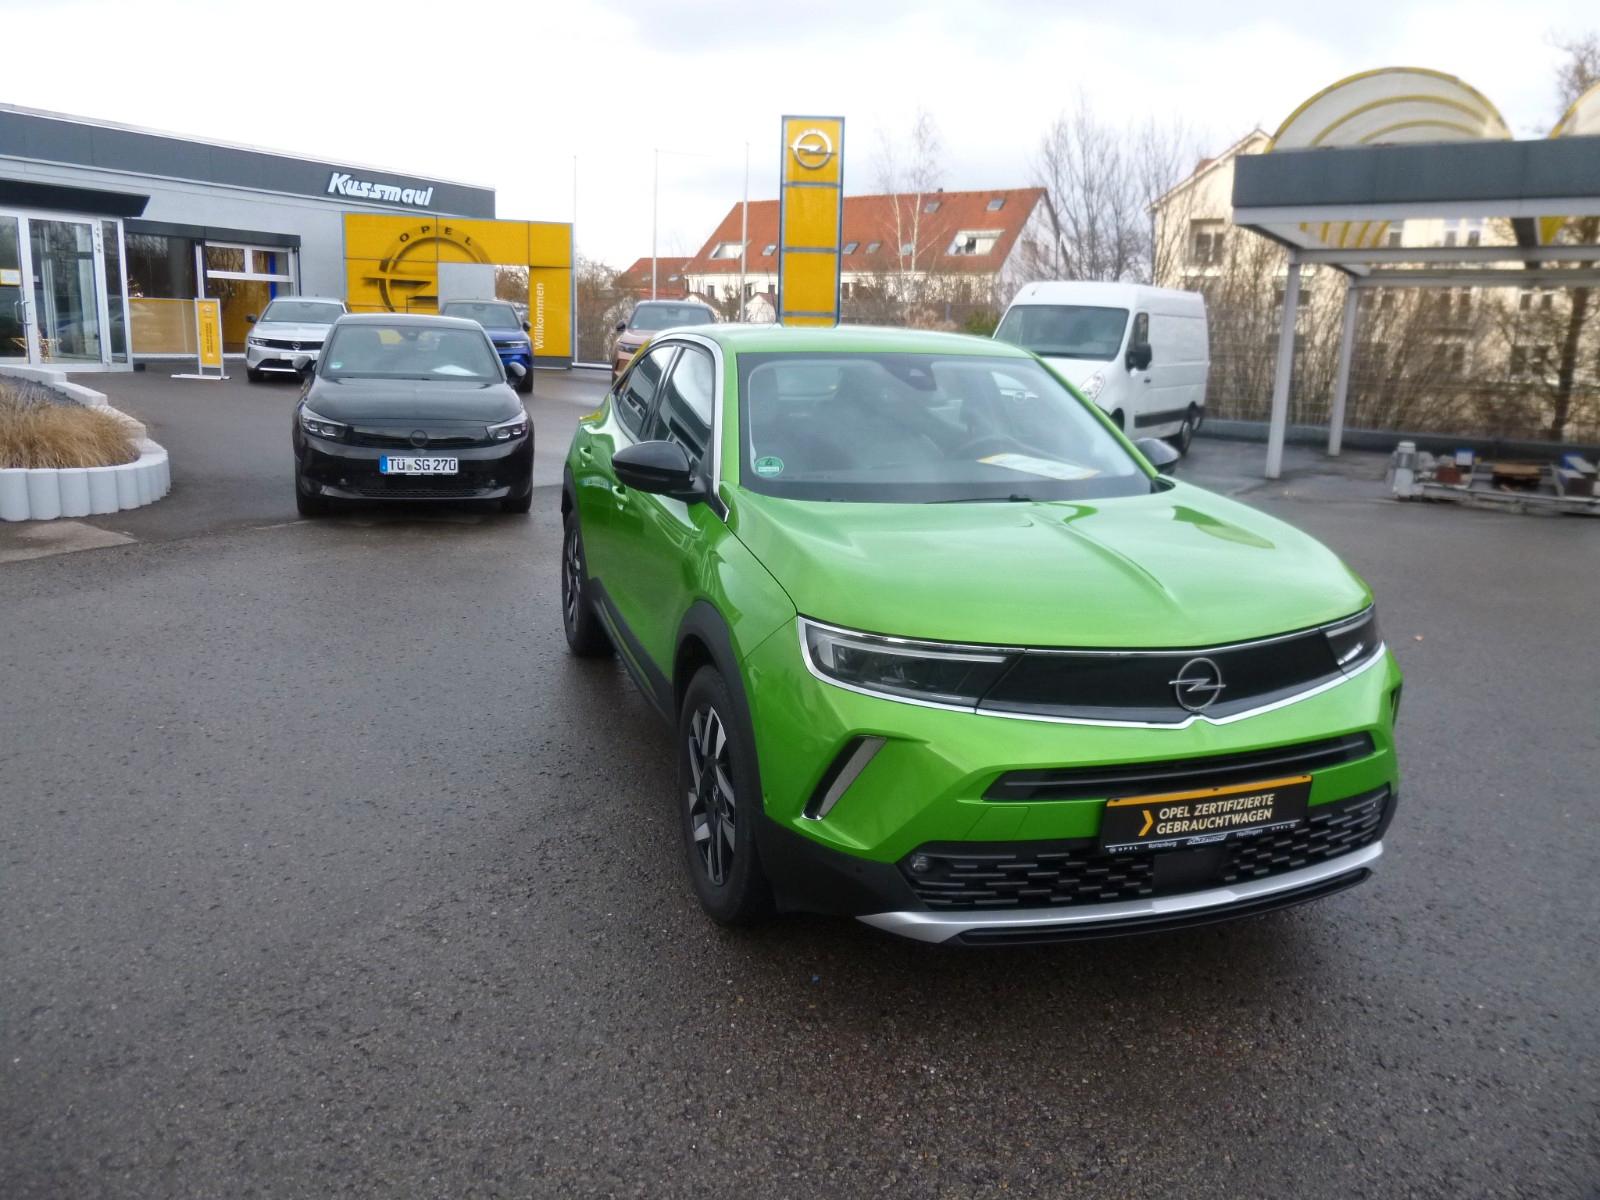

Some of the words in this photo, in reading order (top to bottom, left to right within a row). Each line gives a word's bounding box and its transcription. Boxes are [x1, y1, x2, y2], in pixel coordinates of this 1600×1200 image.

[328, 172, 434, 206] Kussmaul
[399, 225, 473, 246] OPEL
[534, 282, 545, 351] Willkommen
[388, 458, 405, 471] TÜ
[413, 458, 431, 471] SG
[433, 458, 457, 471] 270
[1159, 805, 1190, 820] OPEL
[1193, 793, 1275, 816] ZERTIFIZIERTE
[1156, 808, 1273, 835] GEBRAUCHTWAGEN
